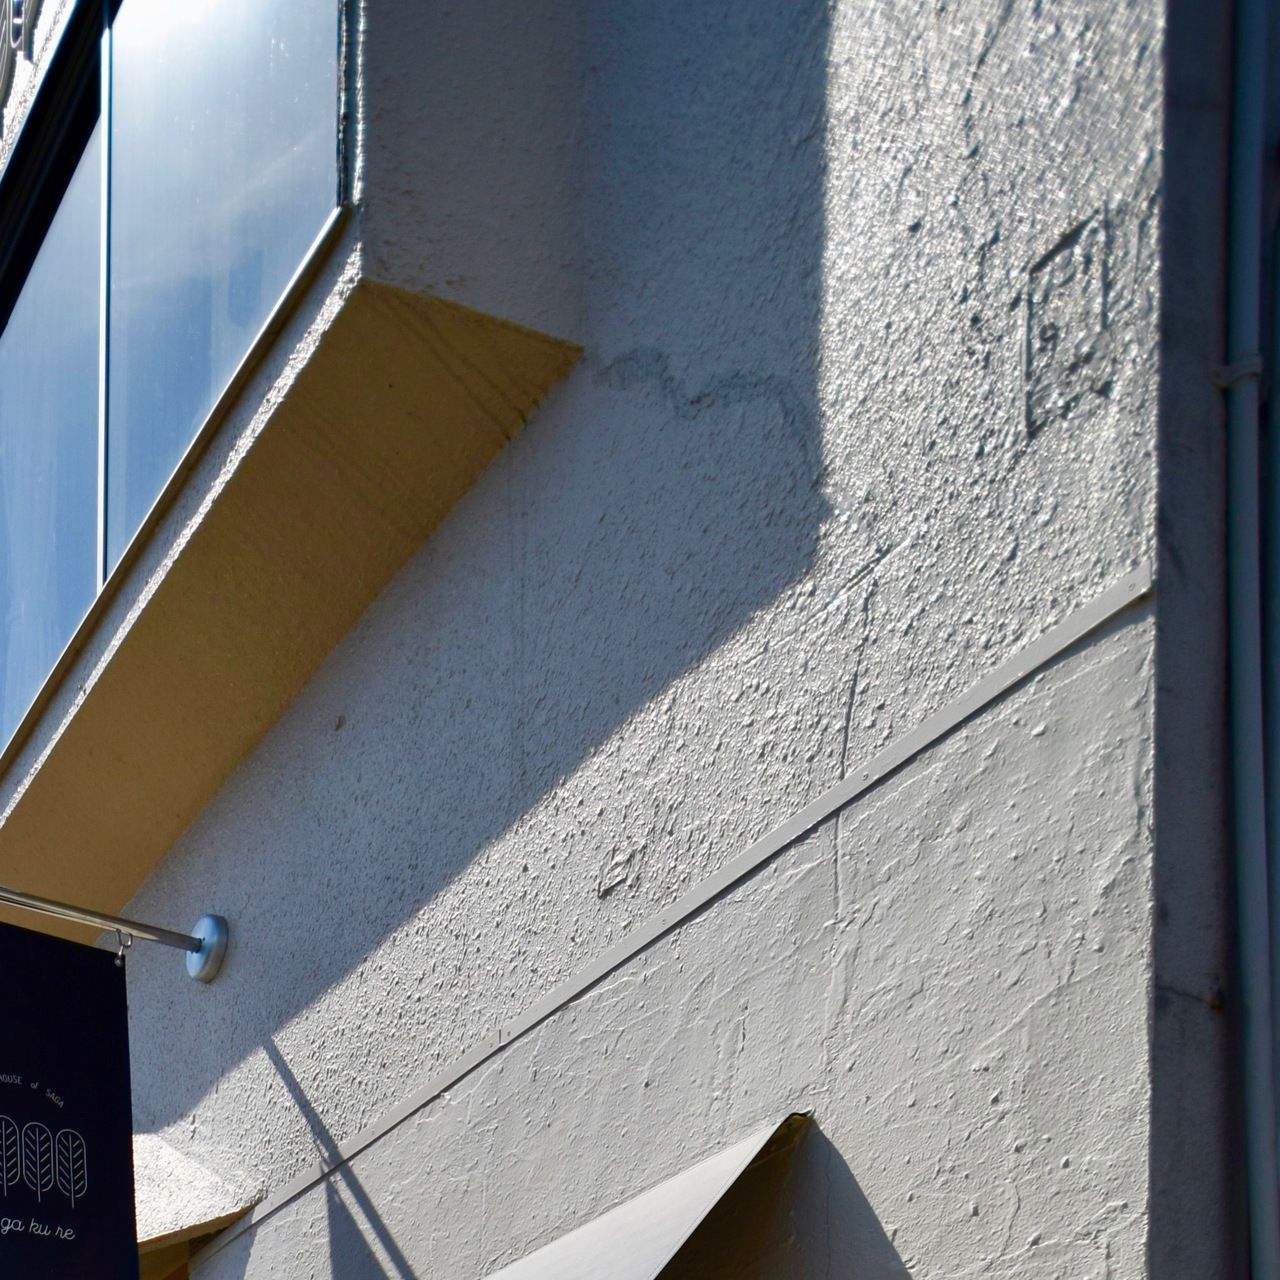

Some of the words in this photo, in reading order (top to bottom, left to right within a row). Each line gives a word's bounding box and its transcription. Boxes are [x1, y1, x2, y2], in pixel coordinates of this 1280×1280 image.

[30, 1081, 40, 1089] of
[45, 1088, 65, 1109] SAGA
[0, 1217, 25, 1235] ga
[28, 1217, 52, 1237] ku
[54, 1224, 76, 1240] re
